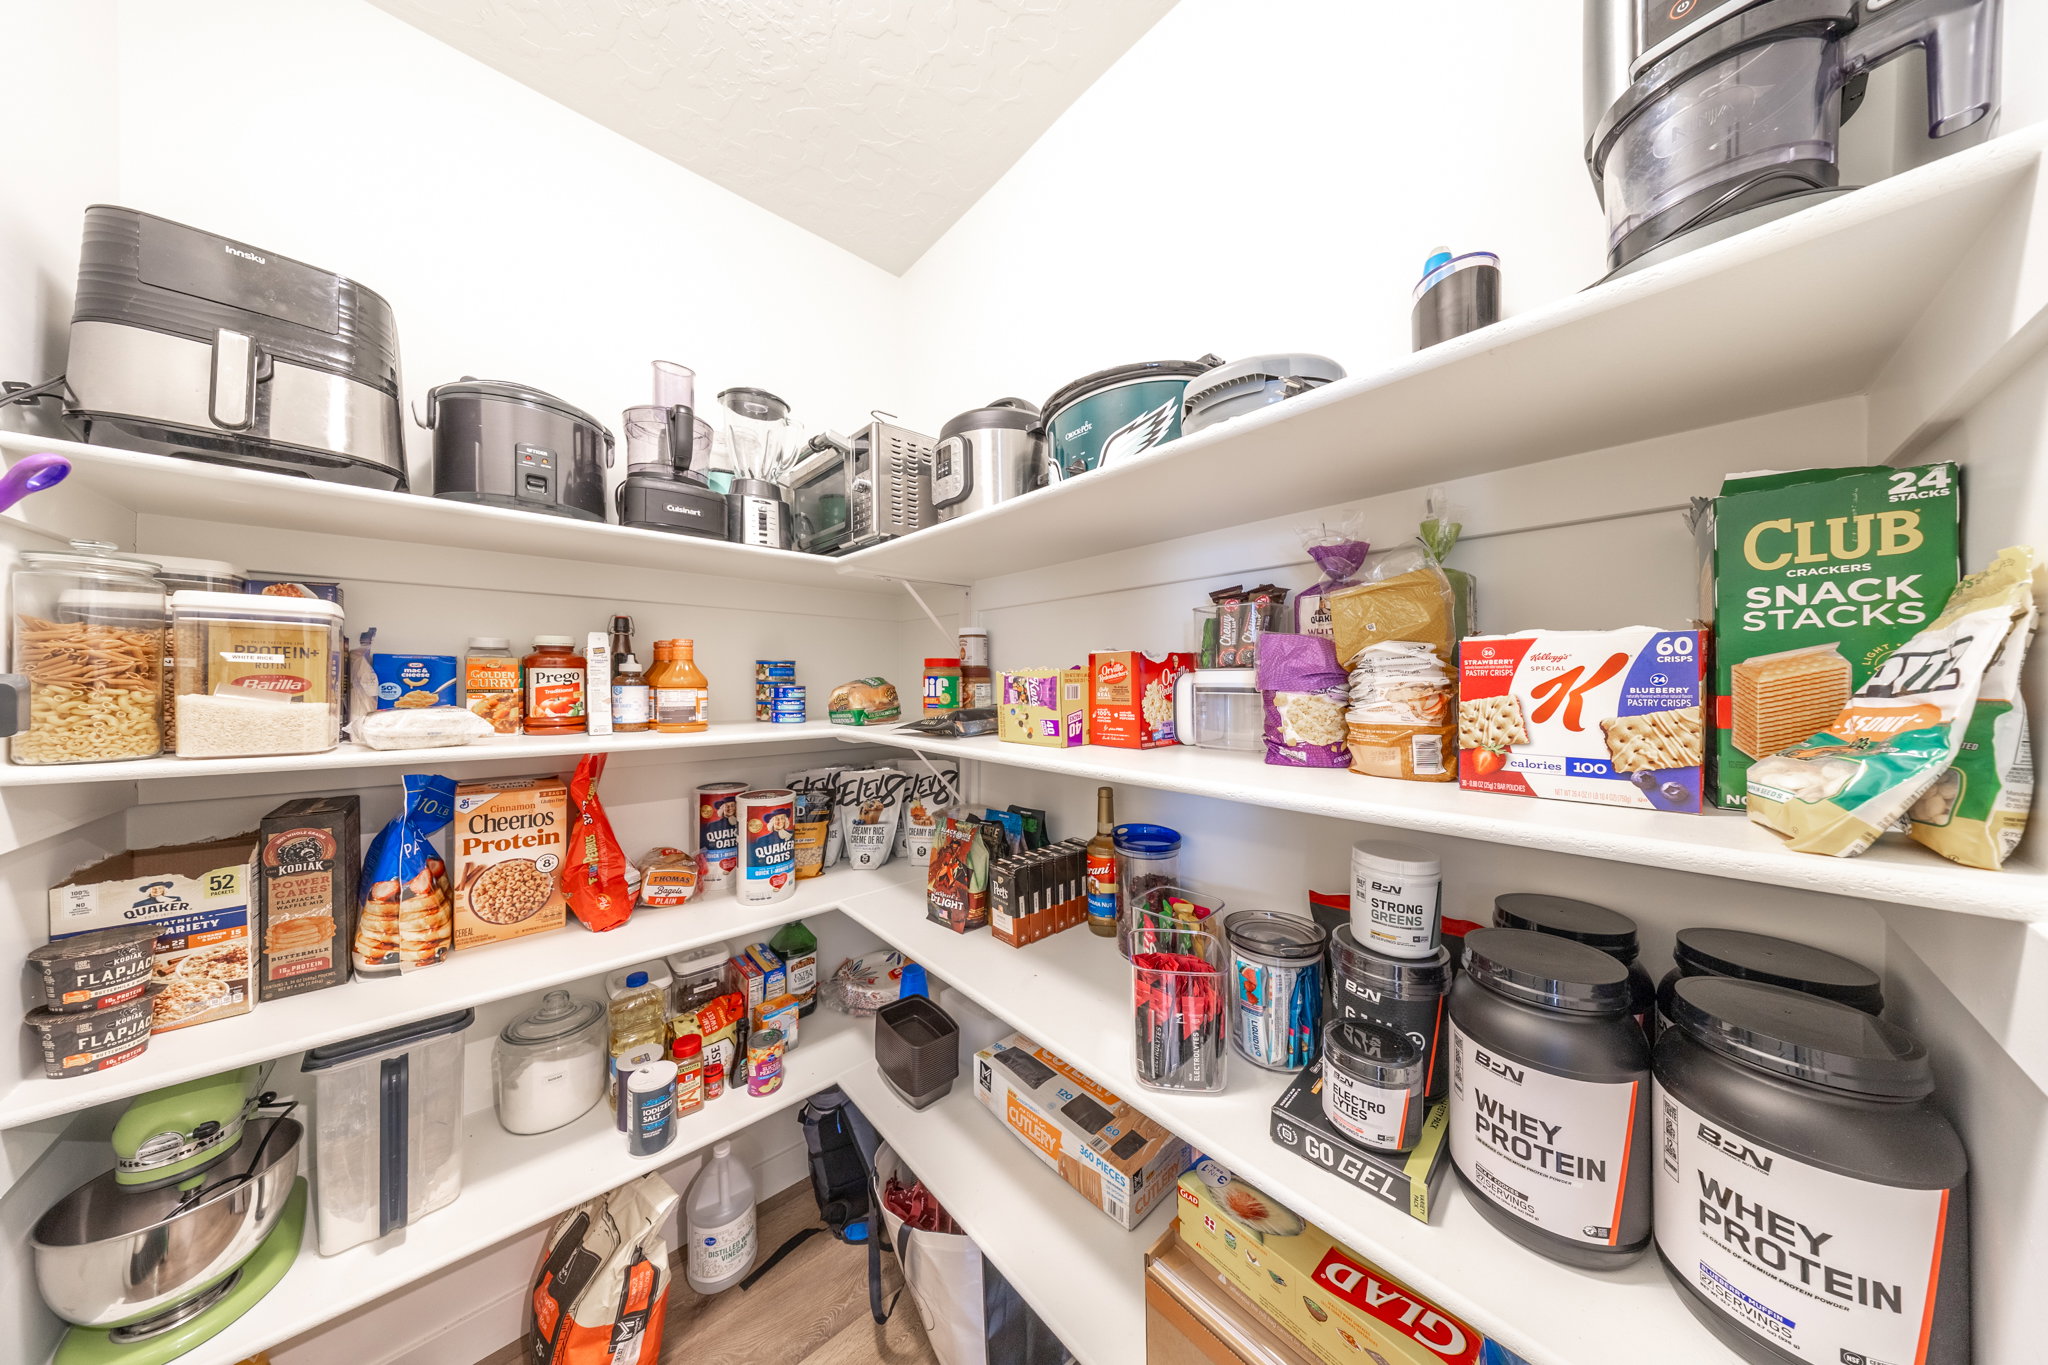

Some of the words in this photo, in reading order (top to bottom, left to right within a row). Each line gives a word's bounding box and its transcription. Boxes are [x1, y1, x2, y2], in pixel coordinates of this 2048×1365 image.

[225, 245, 266, 265] Innsky
[1888, 466, 1952, 495] 24
[1888, 488, 1951, 503] STACKS
[666, 504, 702, 517] Cuisinart
[1743, 510, 1924, 572] CLUB
[1786, 563, 1872, 577] CRACKERS
[1745, 574, 1923, 609] SNACK
[1742, 601, 1927, 632] STACKS
[1220, 613, 1235, 646] Chewy
[1656, 636, 1693, 656] 60
[1530, 652, 1569, 663] Kellogg's
[1862, 643, 1890, 666] LIGHT
[470, 670, 516, 679] GOLDEN
[1101, 663, 1124, 675] Orville
[242, 679, 304, 690] Barilla
[467, 679, 518, 688] CURRY
[535, 672, 580, 685] Prego
[544, 687, 574, 695] Traditional
[923, 677, 949, 697] Jif
[1530, 652, 1629, 732] K
[1627, 699, 1658, 707] PASTRY
[1660, 699, 1692, 707] CRISPS
[1510, 759, 1562, 771] calories
[1573, 762, 1607, 775] 100
[1506, 784, 1526, 792] POUCHES
[417, 797, 439, 814] 10
[437, 807, 450, 816] LB
[490, 802, 536, 814] Cinnamon
[468, 811, 555, 834] Cheerios
[706, 828, 738, 843] QUAK
[851, 826, 872, 836] CREAMY
[872, 826, 885, 835] RICE
[908, 828, 927, 836] CREAMY
[462, 828, 560, 856] Protein
[875, 835, 885, 844] RIZ
[755, 840, 795, 859] QUAKER
[765, 852, 790, 865] OATS
[278, 860, 325, 876] KODIAK
[209, 874, 235, 891] 52
[271, 876, 330, 891] POWER
[653, 876, 690, 884] THOMAS
[210, 889, 235, 897] PACKETS
[274, 884, 328, 899] CAKES
[654, 886, 683, 897] Bagels
[276, 895, 316, 905] FLAPJACK
[277, 902, 307, 911] WAFFLE
[1371, 897, 1423, 915] STRONG
[123, 902, 190, 919] QUAKER
[1371, 909, 1422, 926] GREENS
[163, 919, 220, 936] ARIETY
[230, 928, 242, 936] 15
[455, 928, 474, 938] CEREAL
[113, 951, 143, 966] KODIAK
[271, 947, 330, 962] BUTTERMILK
[77, 955, 153, 987] FLAPJAC
[291, 960, 323, 972] PROTEIN
[794, 968, 813, 979] EXTRA
[793, 973, 814, 984] VIRGIN
[115, 1012, 143, 1027] KODIAK
[707, 1010, 718, 1031] SWEET
[78, 1015, 153, 1050] FLAPJAC
[1058, 1088, 1074, 1100] 120
[1332, 1082, 1386, 1115] ELECTRO
[643, 1099, 673, 1116] IODIZED
[1332, 1095, 1368, 1121] LYTES
[643, 1112, 661, 1123] SALT
[1475, 1087, 1562, 1146] WHEY
[1008, 1105, 1057, 1151] CUTLERY
[1105, 1126, 1120, 1136] 60
[1475, 1111, 1606, 1182] PROTEIN
[1080, 1144, 1094, 1162] 360
[1096, 1157, 1126, 1187] PIECES
[1305, 1135, 1334, 1167] GO
[1337, 1153, 1397, 1202] GEL
[1742, 1160, 1770, 1176] NUTRITION
[1526, 1167, 1549, 1178] PROTEIN
[1549, 1175, 1572, 1185] POWDER
[1135, 1159, 1180, 1214] CUTLERY
[1179, 1188, 1199, 1205] GLAD
[1485, 1179, 1535, 1214] SERVINGS
[1697, 1168, 1833, 1257] WHEY
[707, 1240, 741, 1259] DISTILLED
[721, 1240, 748, 1262] VINEGAR
[1699, 1198, 1902, 1314] PROTEIN
[1709, 1235, 1732, 1254] GRAMS
[1732, 1252, 1742, 1260] OF
[1743, 1258, 1778, 1281] PREMIUM
[1779, 1278, 1813, 1298] PROTEIN
[1814, 1295, 1851, 1312] POWDER
[1700, 1282, 1709, 1290] NET
[1700, 1263, 1747, 1300] BLUEBERRY
[1747, 1297, 1784, 1323] MUFFIN
[1324, 1262, 1468, 1356] GLAD
[1701, 1274, 1713, 1286] 27
[1715, 1283, 1793, 1339] SERVINGS
[1846, 1354, 1860, 1365] NSF
